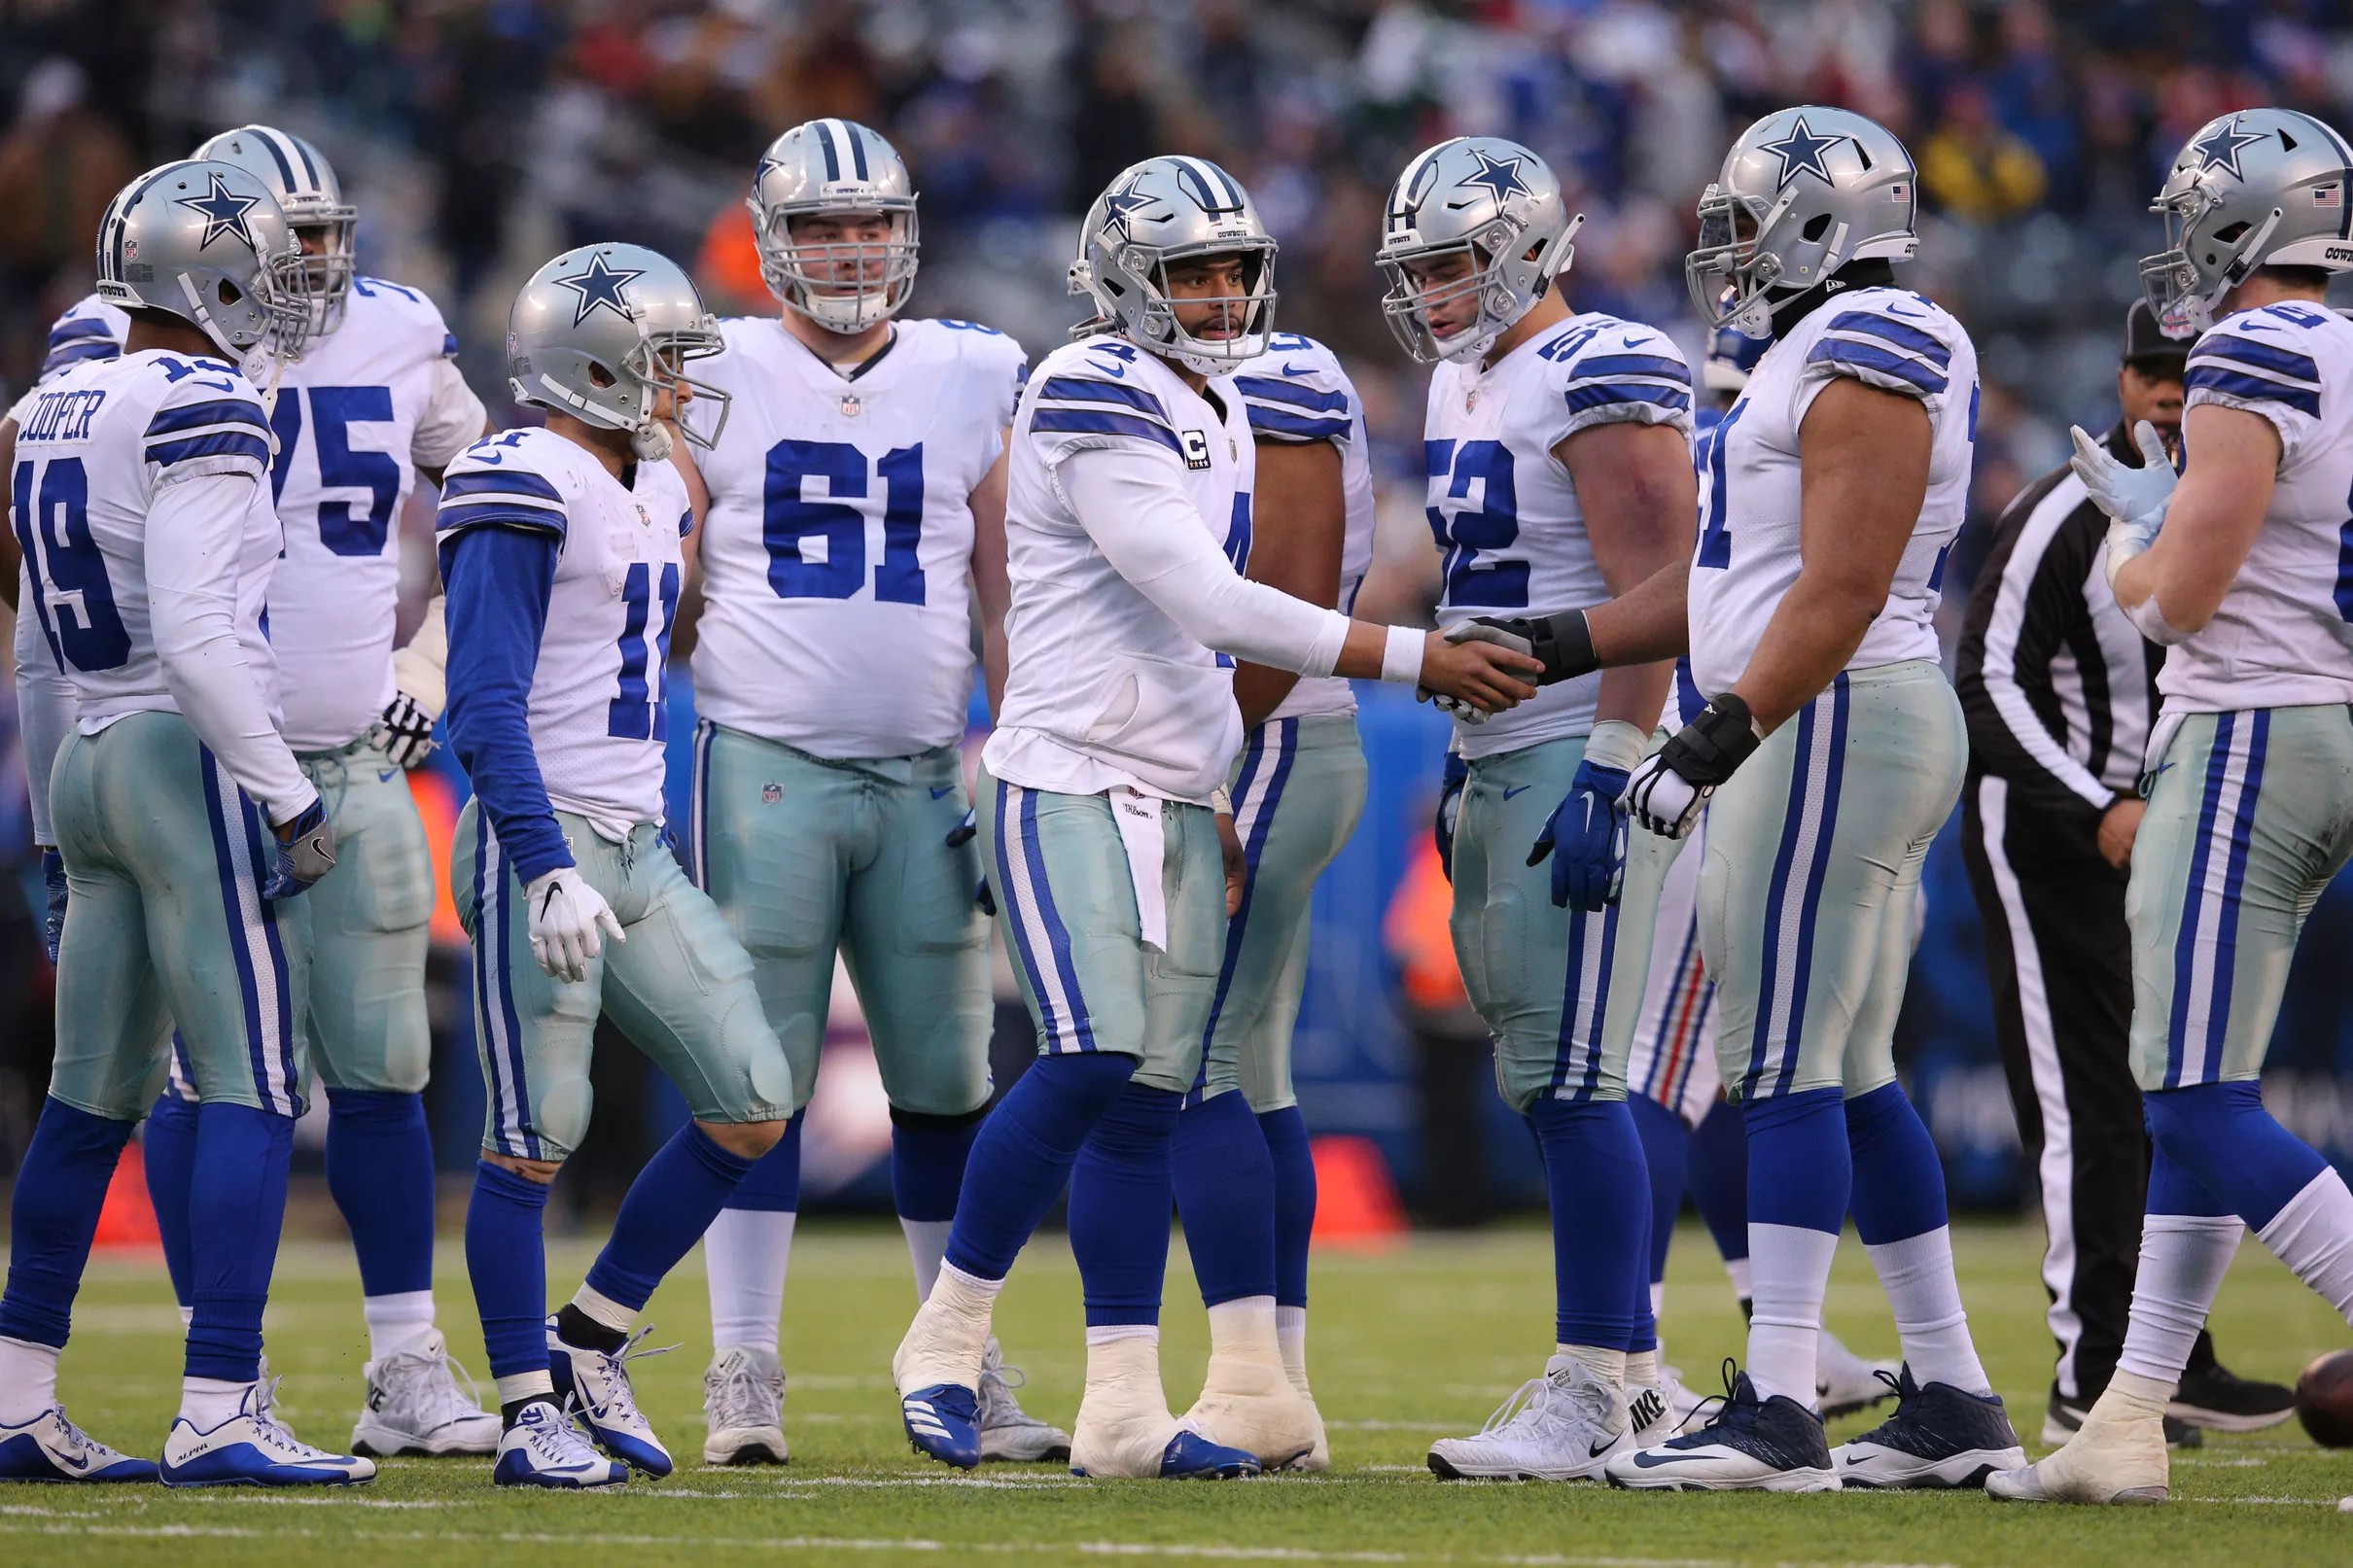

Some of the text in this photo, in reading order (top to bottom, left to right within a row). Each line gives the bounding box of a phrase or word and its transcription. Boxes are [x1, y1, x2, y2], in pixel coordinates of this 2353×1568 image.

[1217, 229, 1247, 238] COWBOYS
[255, 386, 400, 559] 75
[763, 439, 926, 607] 61
[1183, 431, 1207, 460] C
[1424, 439, 1530, 609] 52
[11, 457, 132, 675] 19
[608, 563, 680, 740] 11
[175, 1443, 209, 1463] ALPHA
